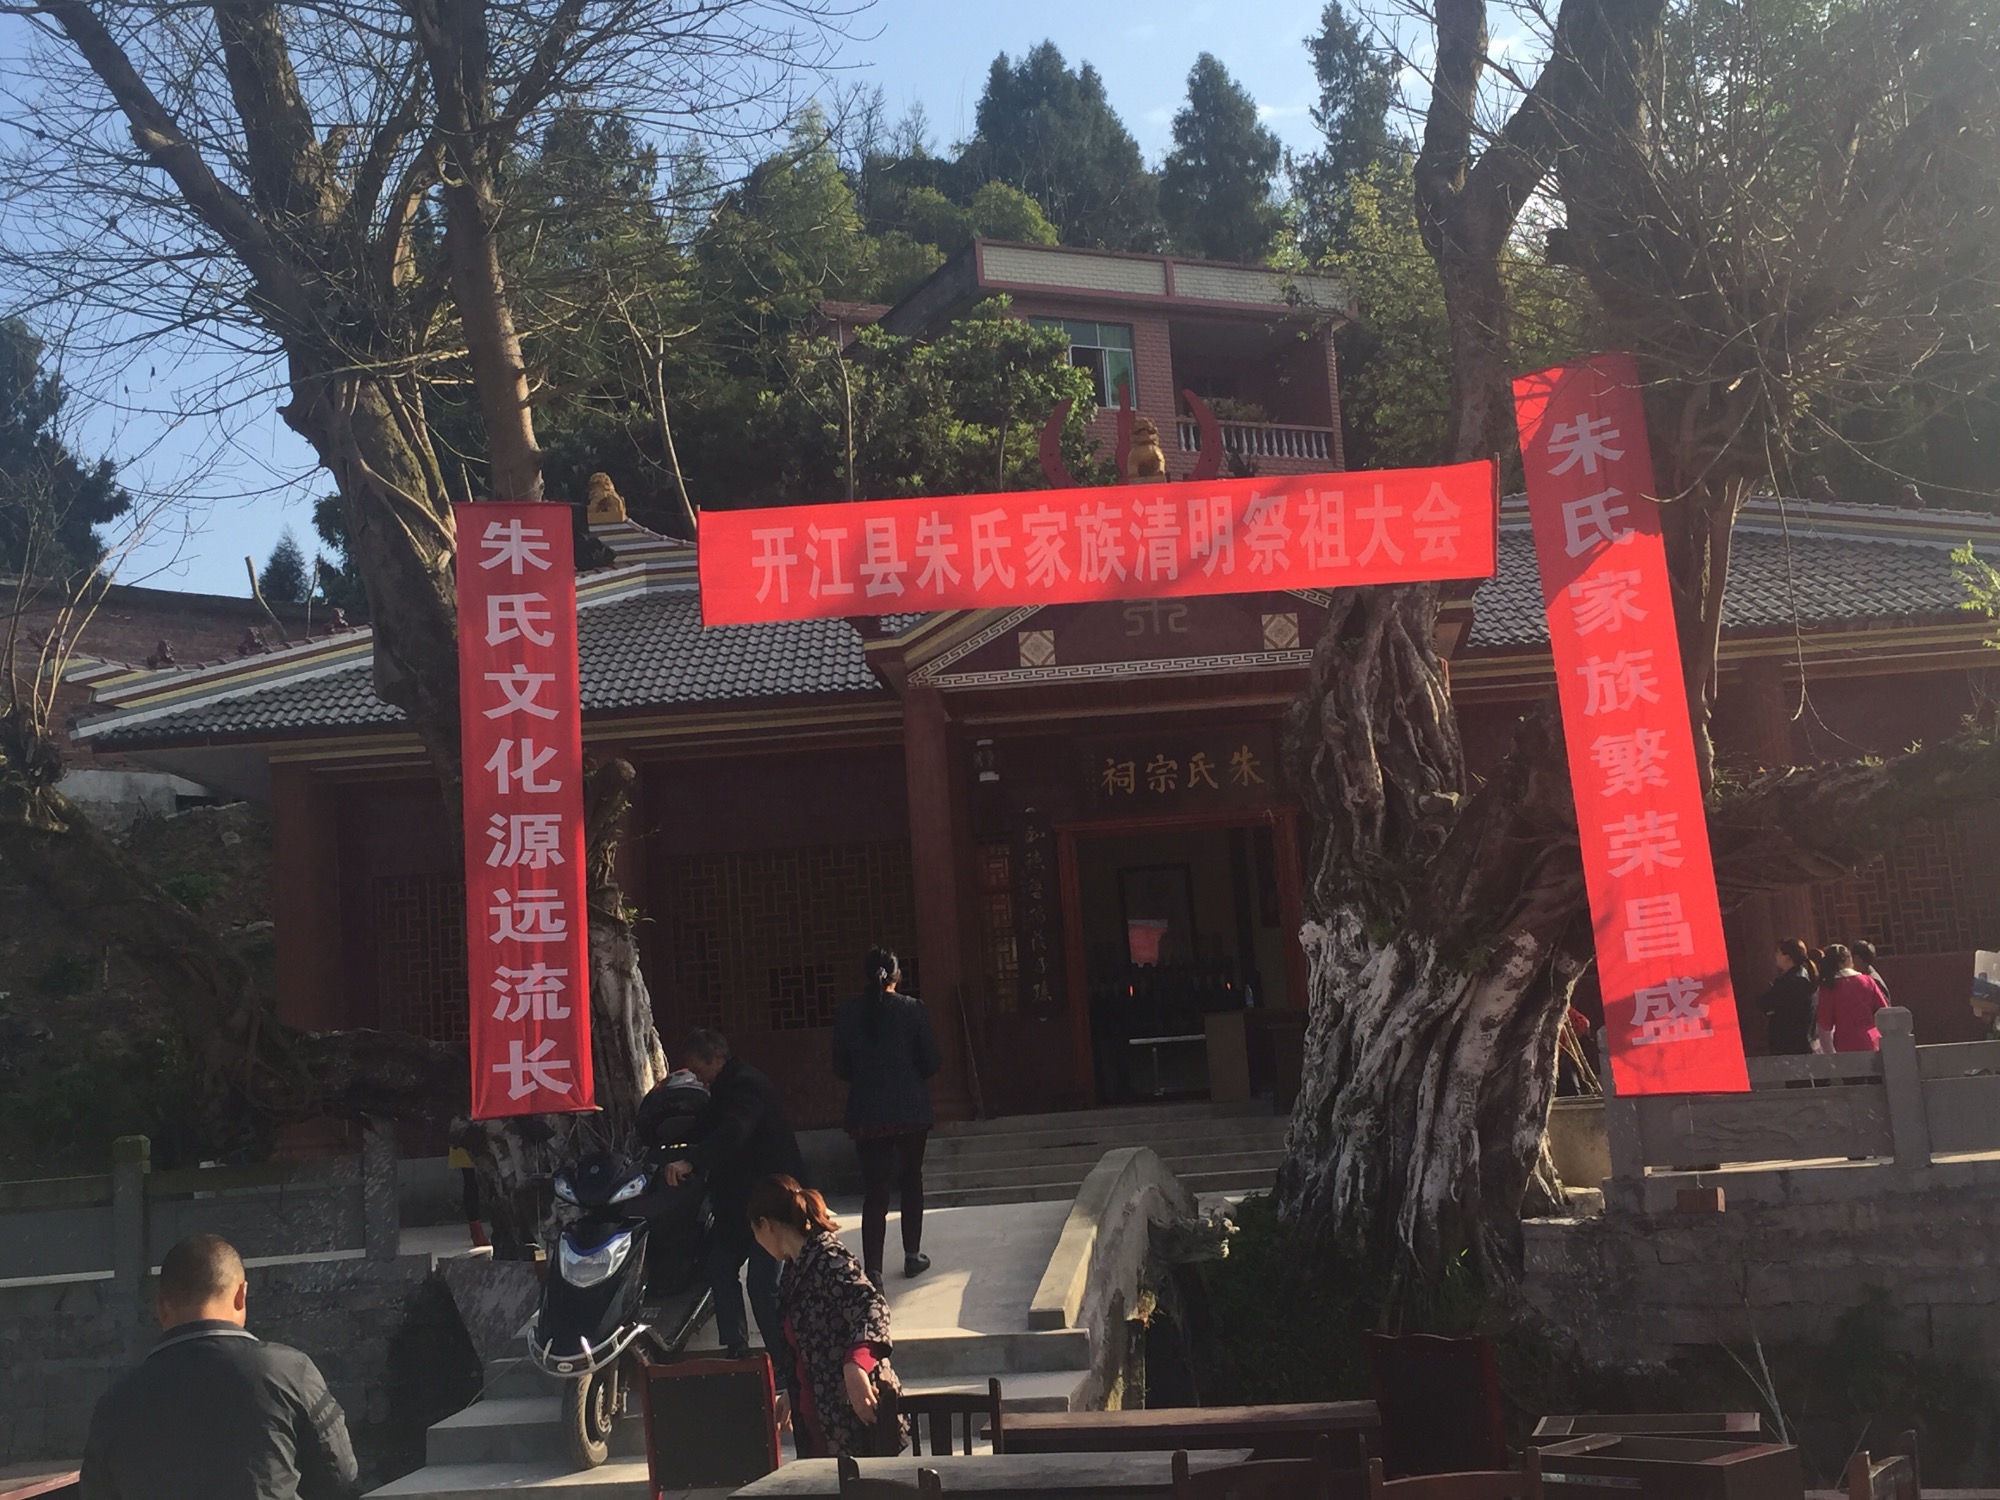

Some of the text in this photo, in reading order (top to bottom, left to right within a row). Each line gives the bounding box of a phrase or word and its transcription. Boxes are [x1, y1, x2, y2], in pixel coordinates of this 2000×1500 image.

[751, 481, 1462, 604] 开江县朱氏家族清明祭祖大会
[478, 519, 574, 1100] 朱氏文化源远流长
[1101, 744, 1265, 796] 朱氏宗祠
[1547, 413, 1714, 1046] 朱氏家族繁荣昌盛
